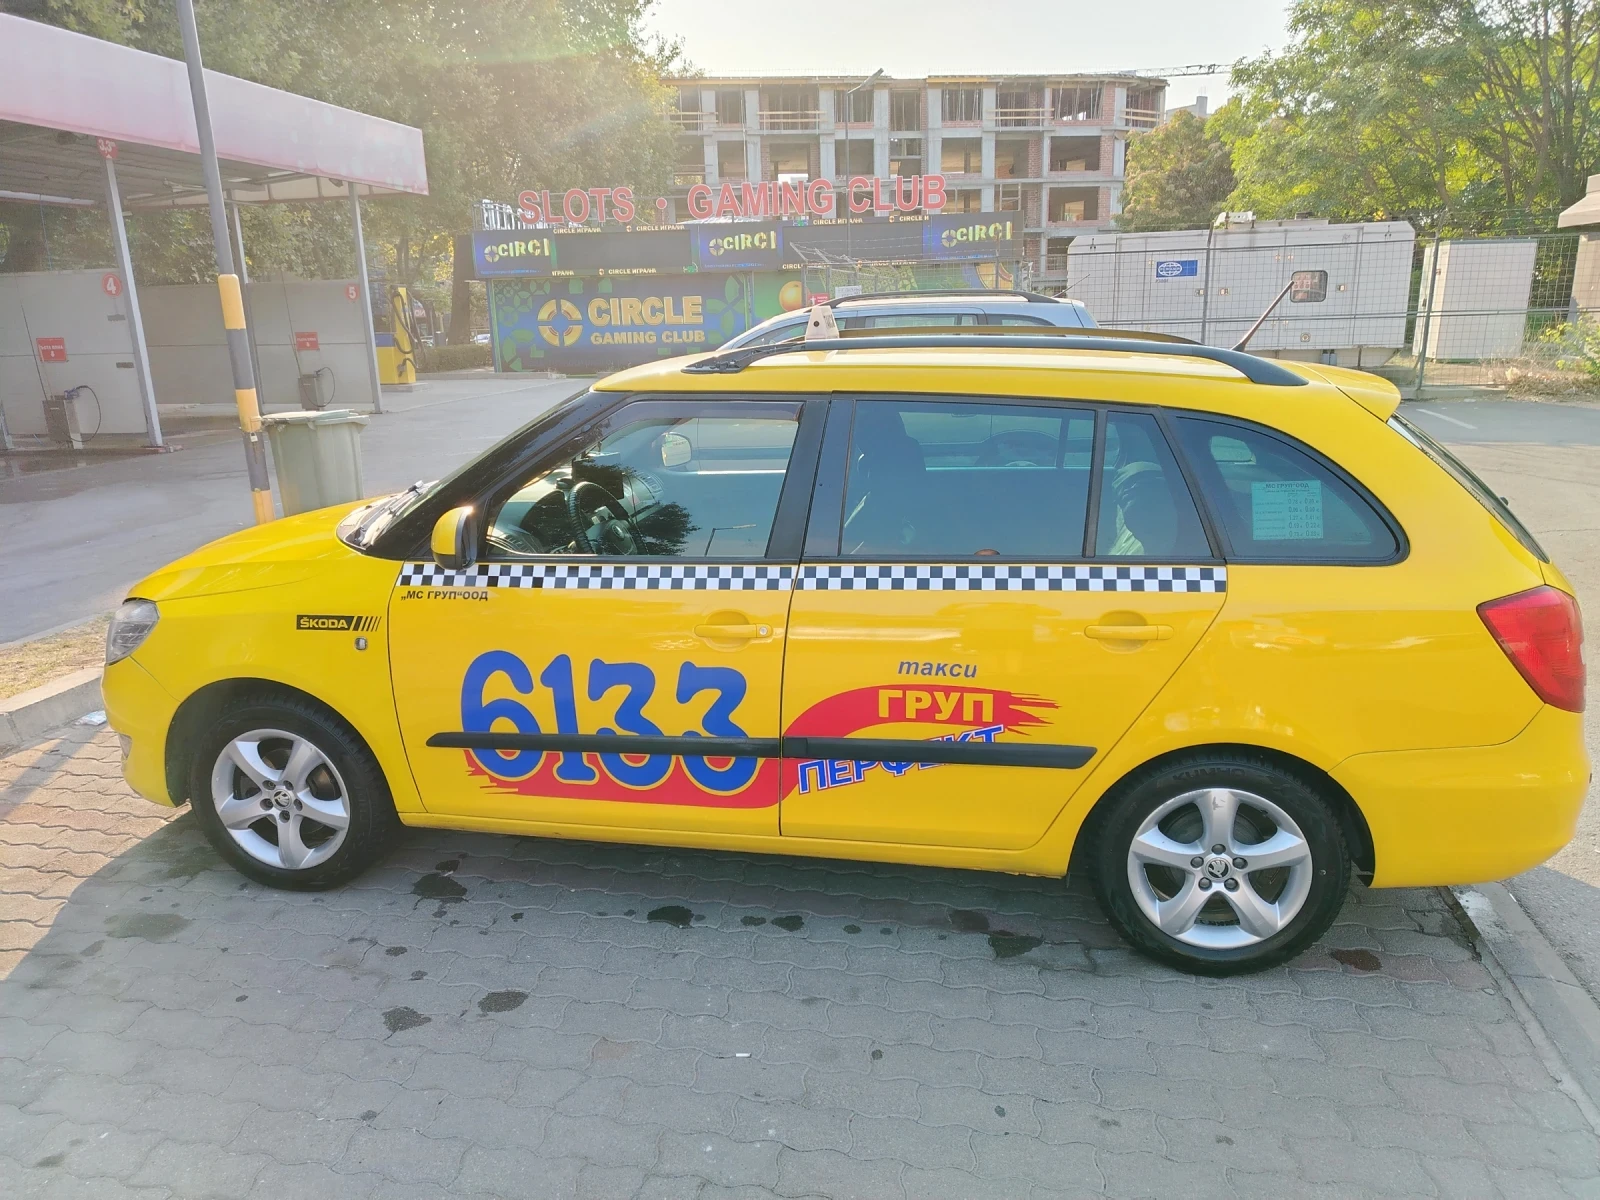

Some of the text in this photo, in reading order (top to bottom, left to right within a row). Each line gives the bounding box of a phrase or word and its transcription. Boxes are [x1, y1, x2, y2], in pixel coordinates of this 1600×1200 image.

[518, 174, 947, 225] SLOTS GAMING CLUB
[106, 277, 117, 294] 4
[348, 286, 357, 299] 5
[588, 295, 704, 327] CIRCLE
[590, 330, 706, 345] GAMING CLUB
[300, 616, 348, 629] ŠKODA
[898, 660, 977, 678] такси
[878, 689, 995, 723] ГРУП
[460, 649, 760, 795] 6133
